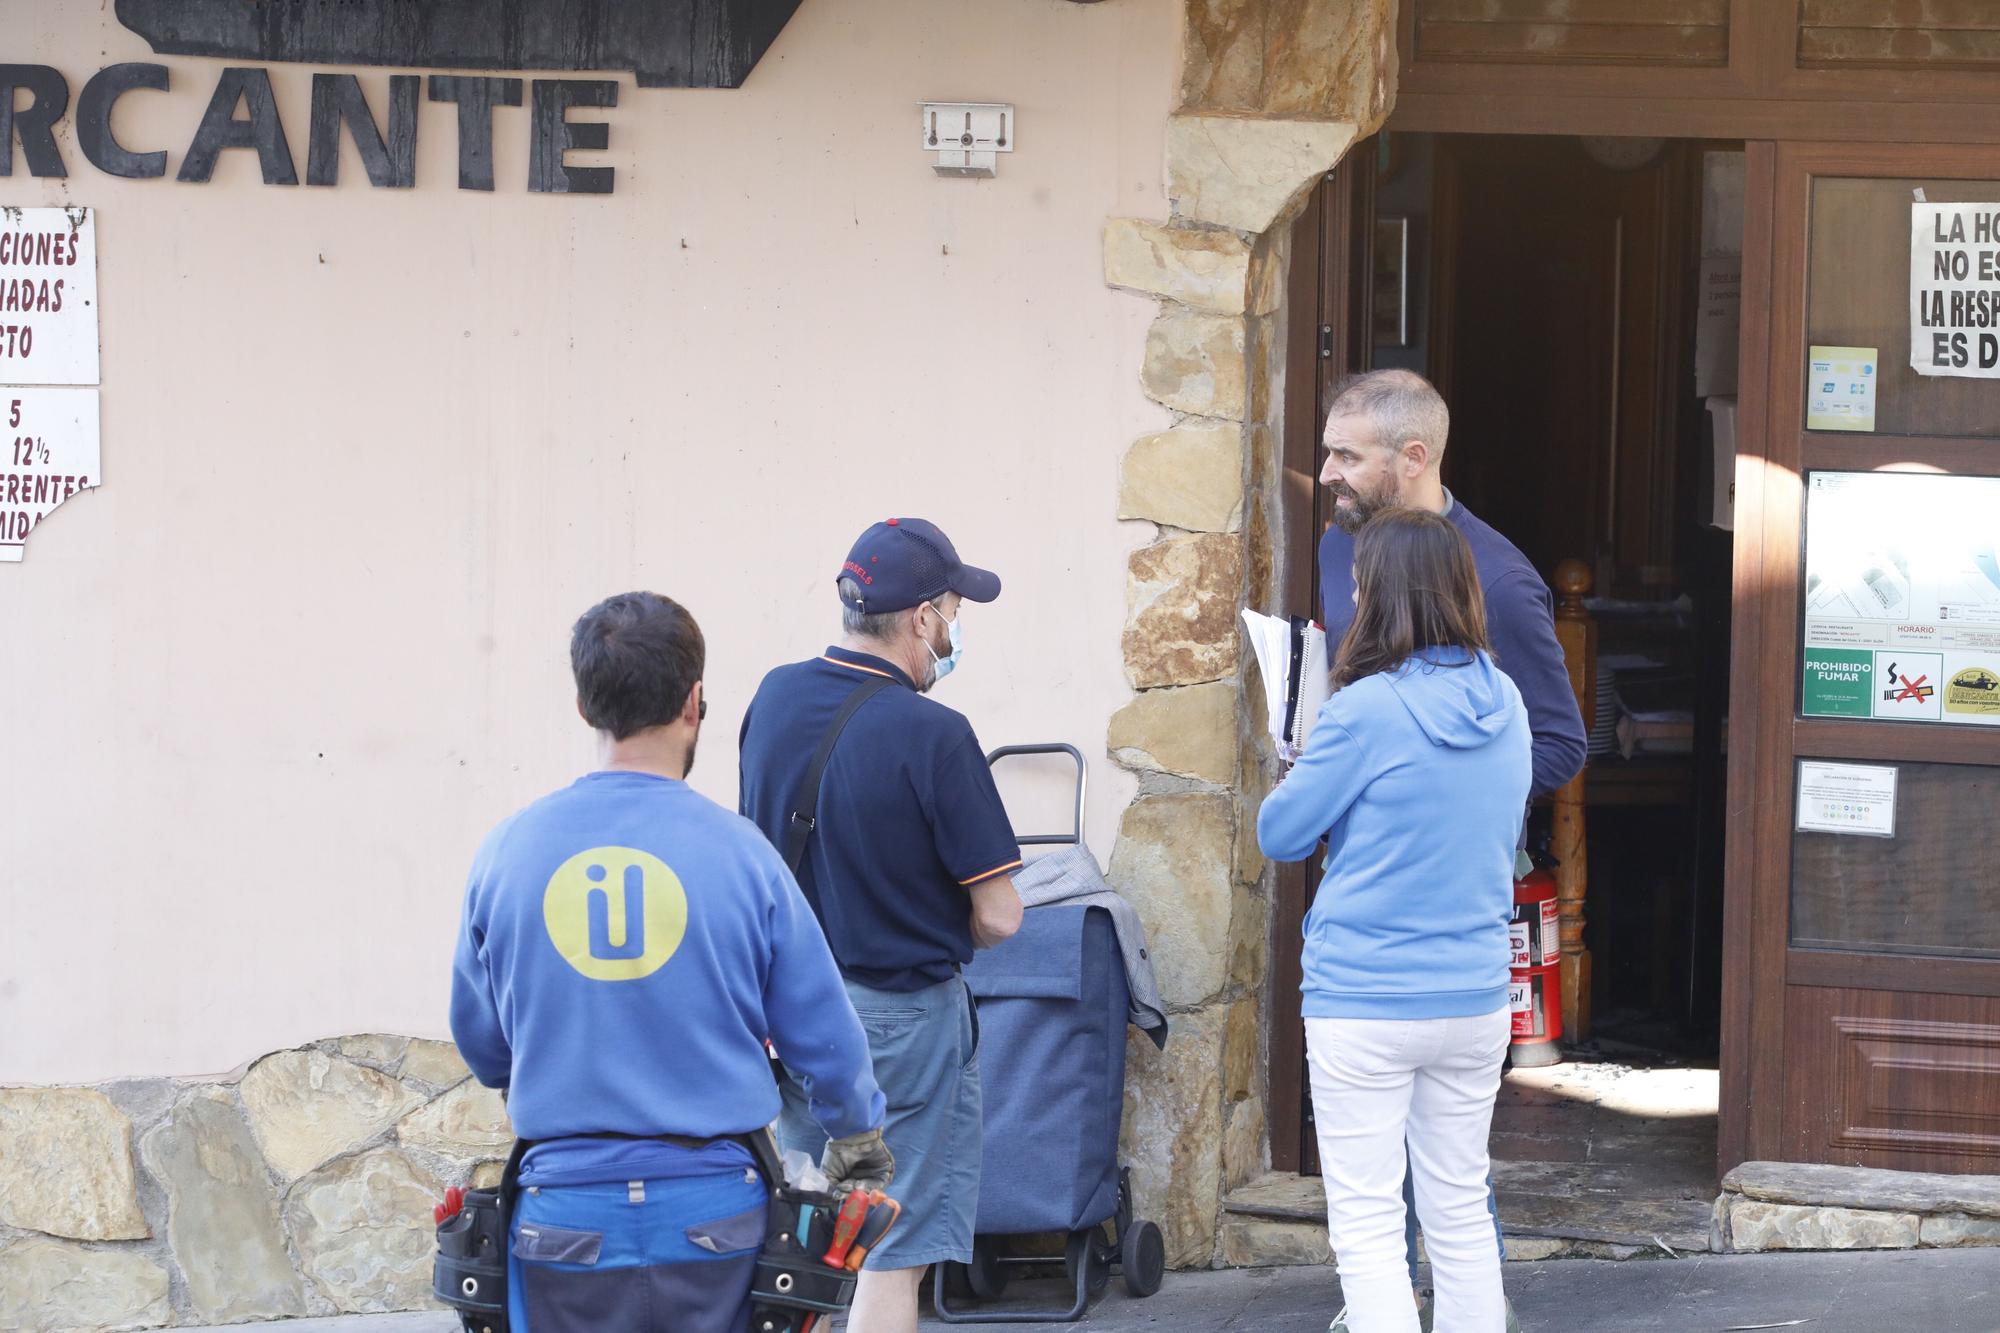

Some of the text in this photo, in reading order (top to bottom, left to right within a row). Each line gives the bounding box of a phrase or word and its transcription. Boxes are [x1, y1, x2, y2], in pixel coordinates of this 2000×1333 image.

[0, 62, 619, 194] RCANTE
[1934, 213, 1966, 243] LA
[0, 232, 79, 266] CIONES
[1934, 250, 1969, 281] NO
[1921, 290, 2000, 328] LA RESP
[1932, 332, 1969, 368] ES
[9, 399, 22, 428] 5
[1806, 661, 1872, 673] PROHIBIDO
[1818, 671, 1860, 682] FUMAR
